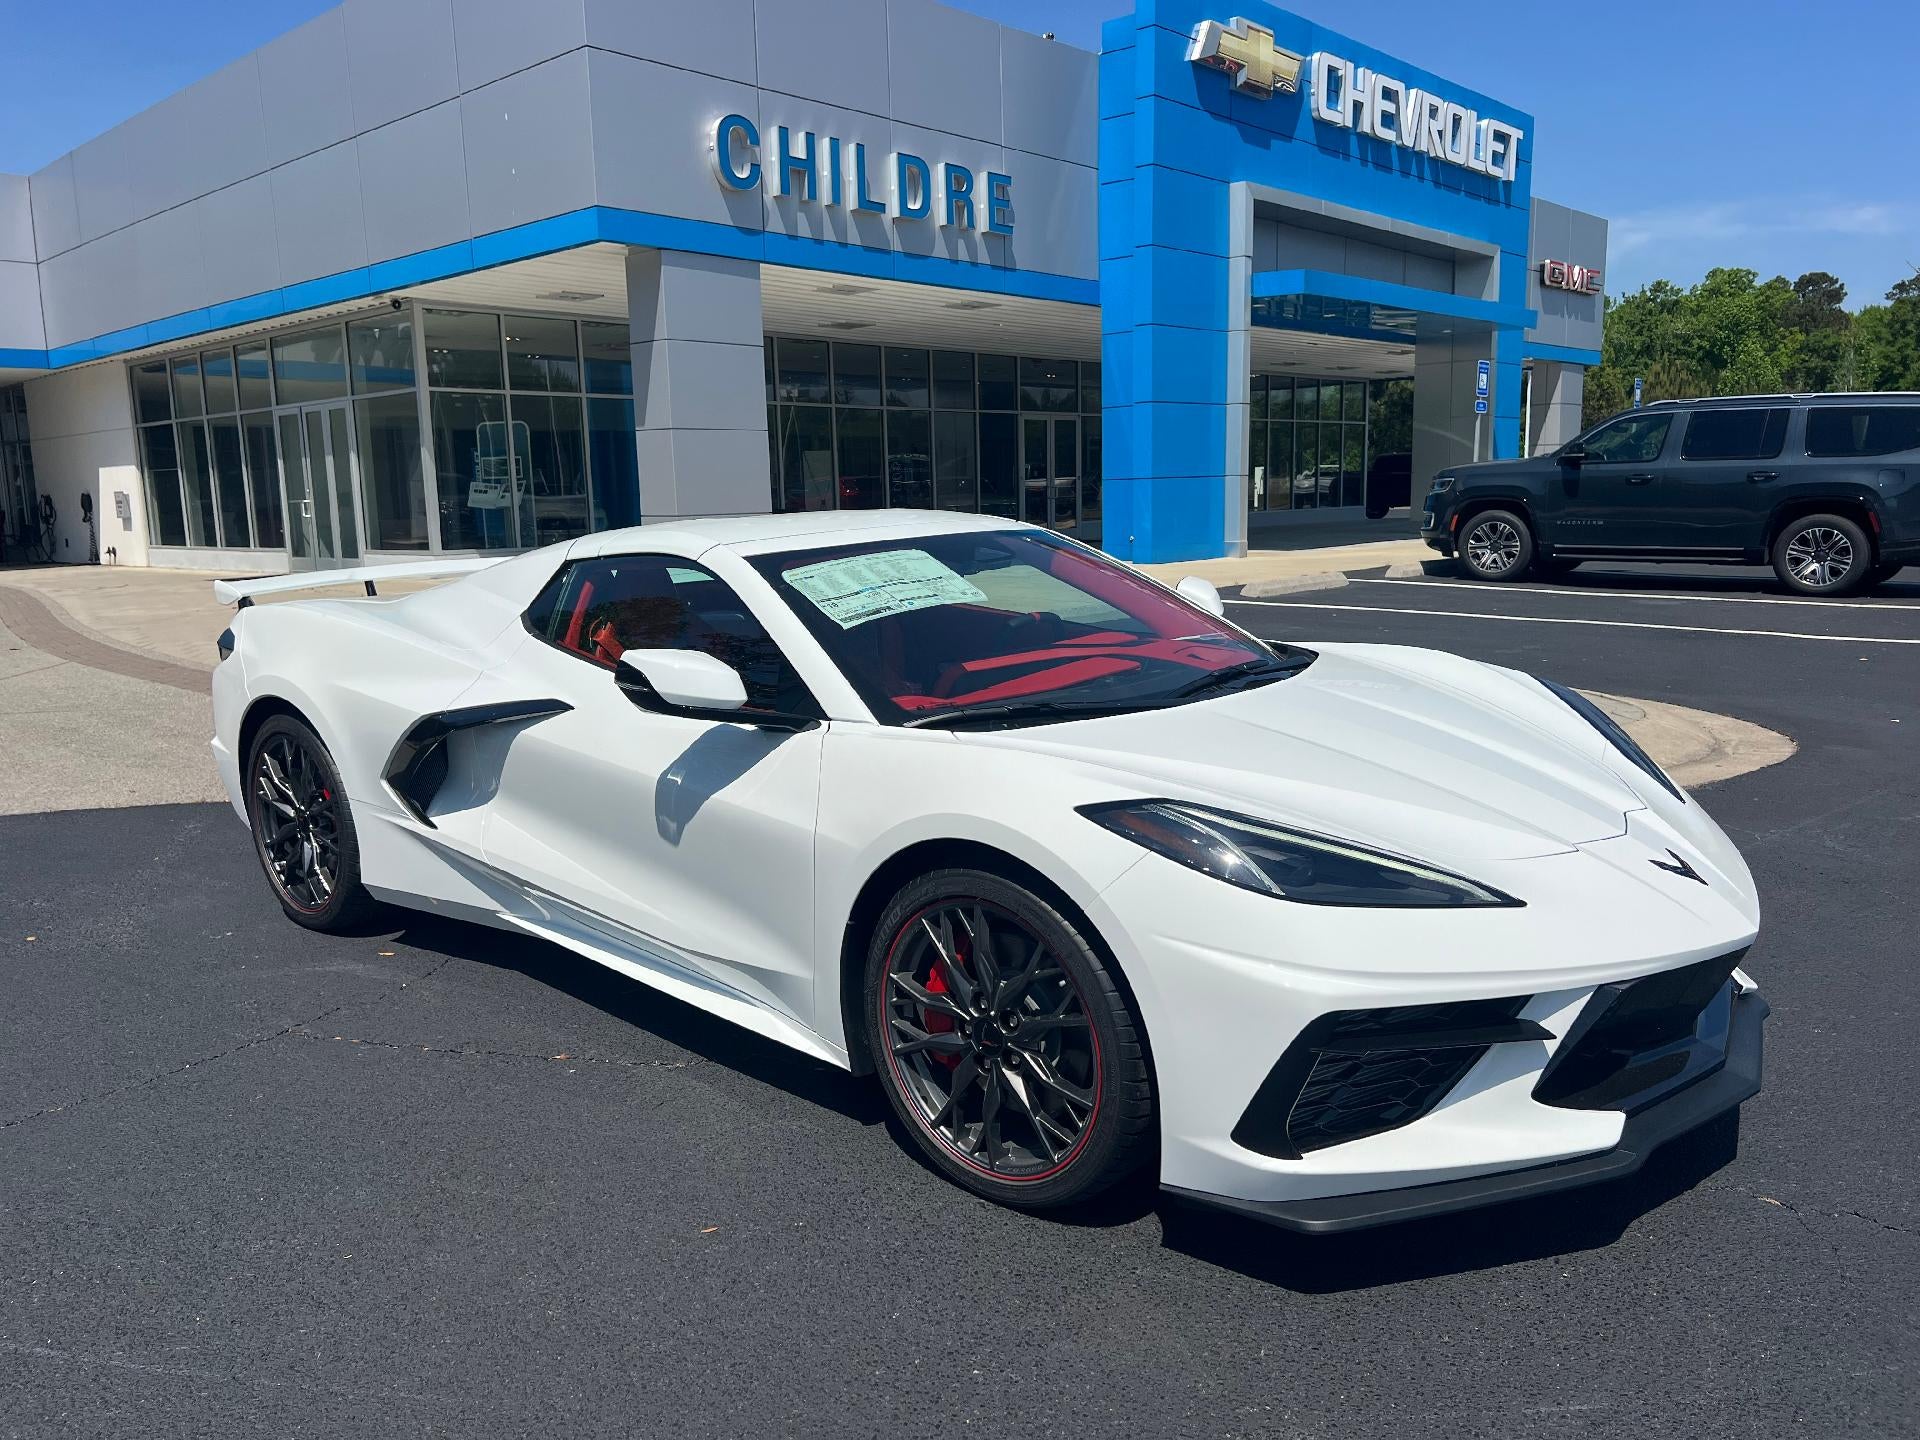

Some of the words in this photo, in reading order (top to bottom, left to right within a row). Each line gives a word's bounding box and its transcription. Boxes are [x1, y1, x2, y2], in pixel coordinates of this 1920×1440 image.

[711, 113, 1014, 235] CHILDRE
[1311, 51, 1524, 181] CHEVROLET
[1543, 259, 1600, 294] GMC
